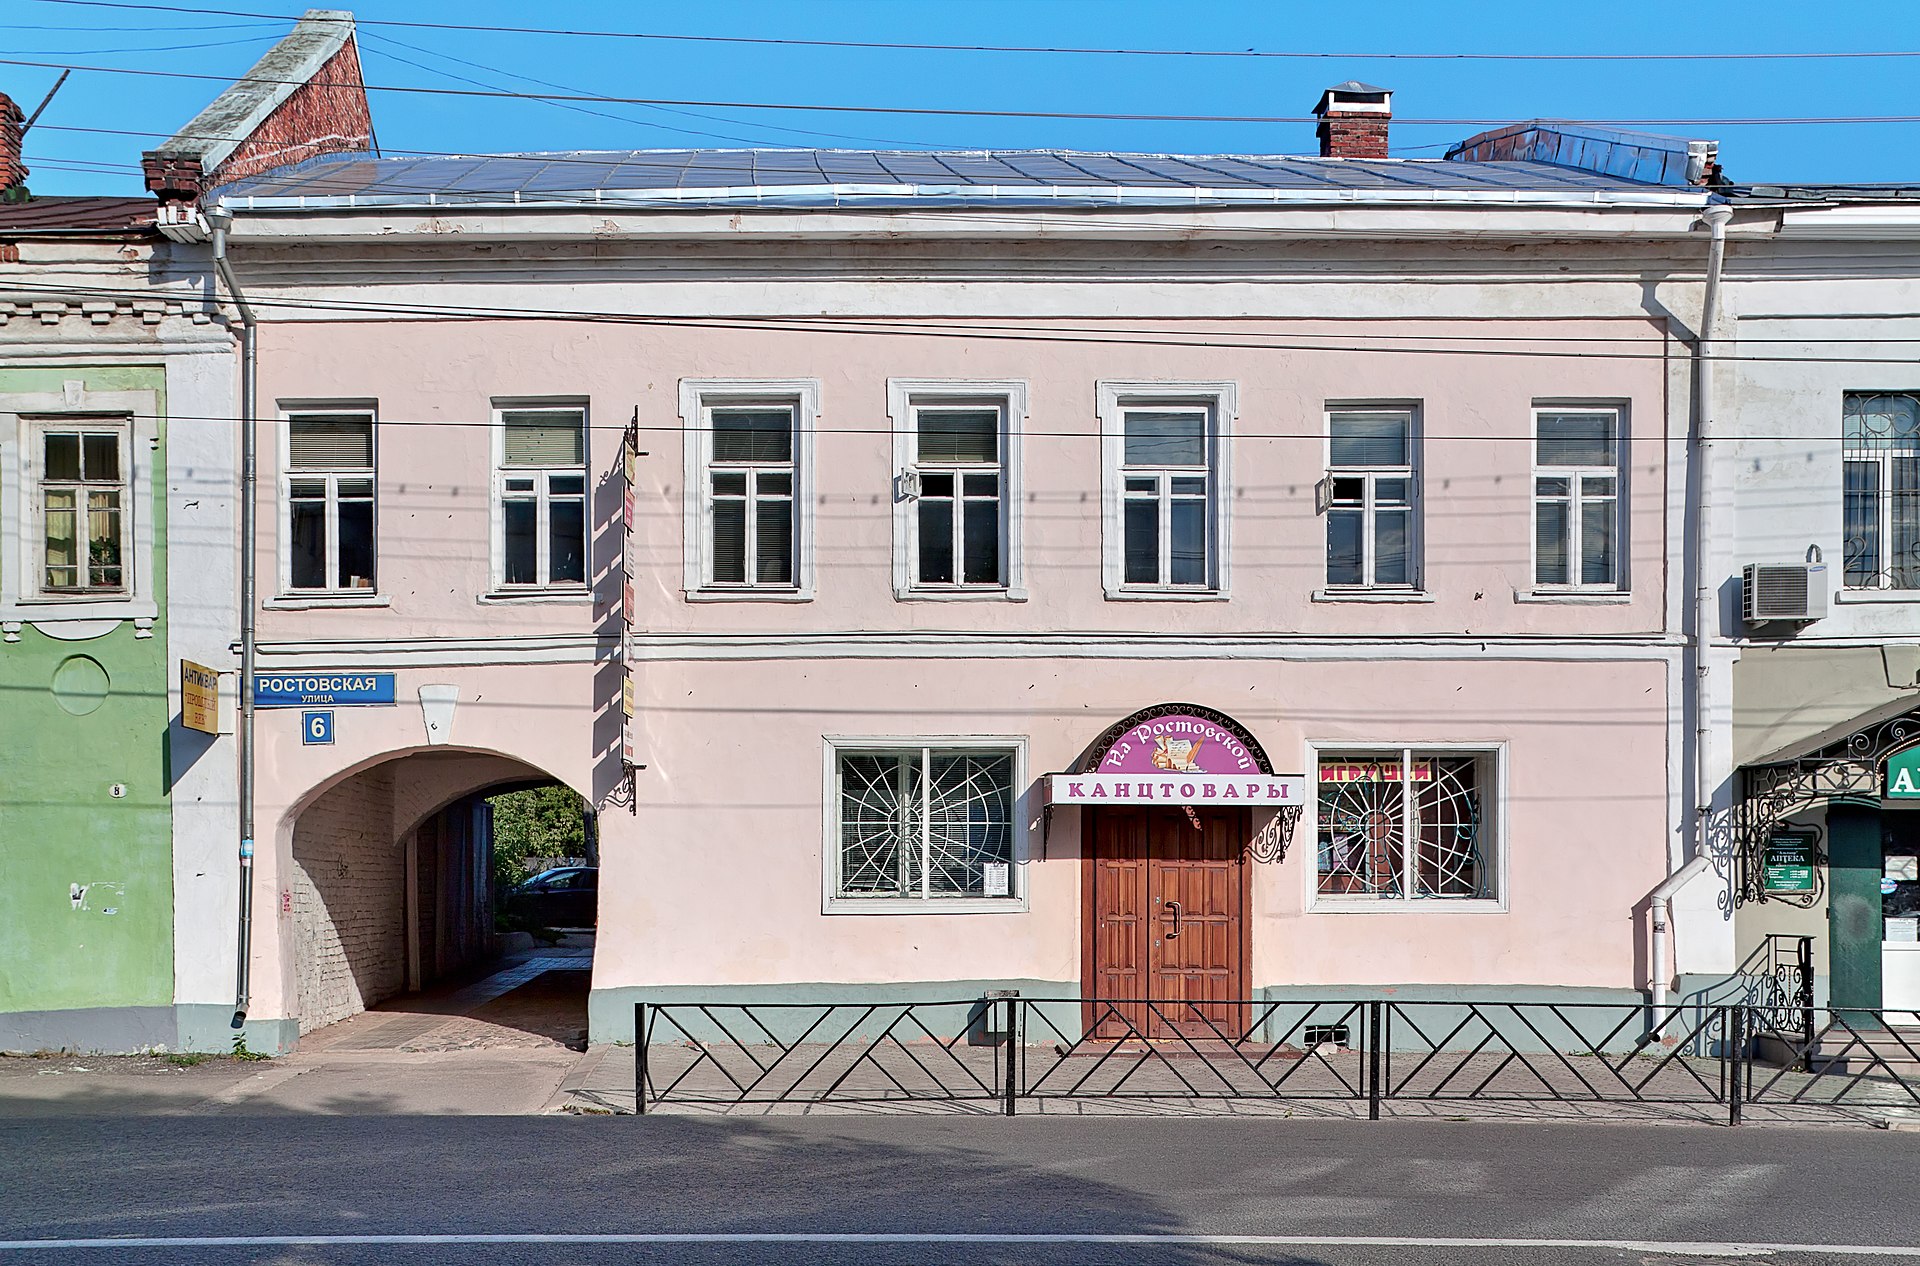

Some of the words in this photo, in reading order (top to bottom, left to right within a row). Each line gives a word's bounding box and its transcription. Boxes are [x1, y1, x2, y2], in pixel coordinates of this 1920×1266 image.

[259, 677, 377, 692] РОСТОВСКАЯ
[301, 694, 335, 703] УЛИЦА
[310, 717, 326, 738] 6
[1105, 741, 1132, 767] На
[1132, 720, 1253, 770] Ростовской
[1889, 767, 1920, 793] А
[1068, 782, 1289, 800] КАНЦТОВАРЫ
[1770, 855, 1805, 863] АПТЕКА
